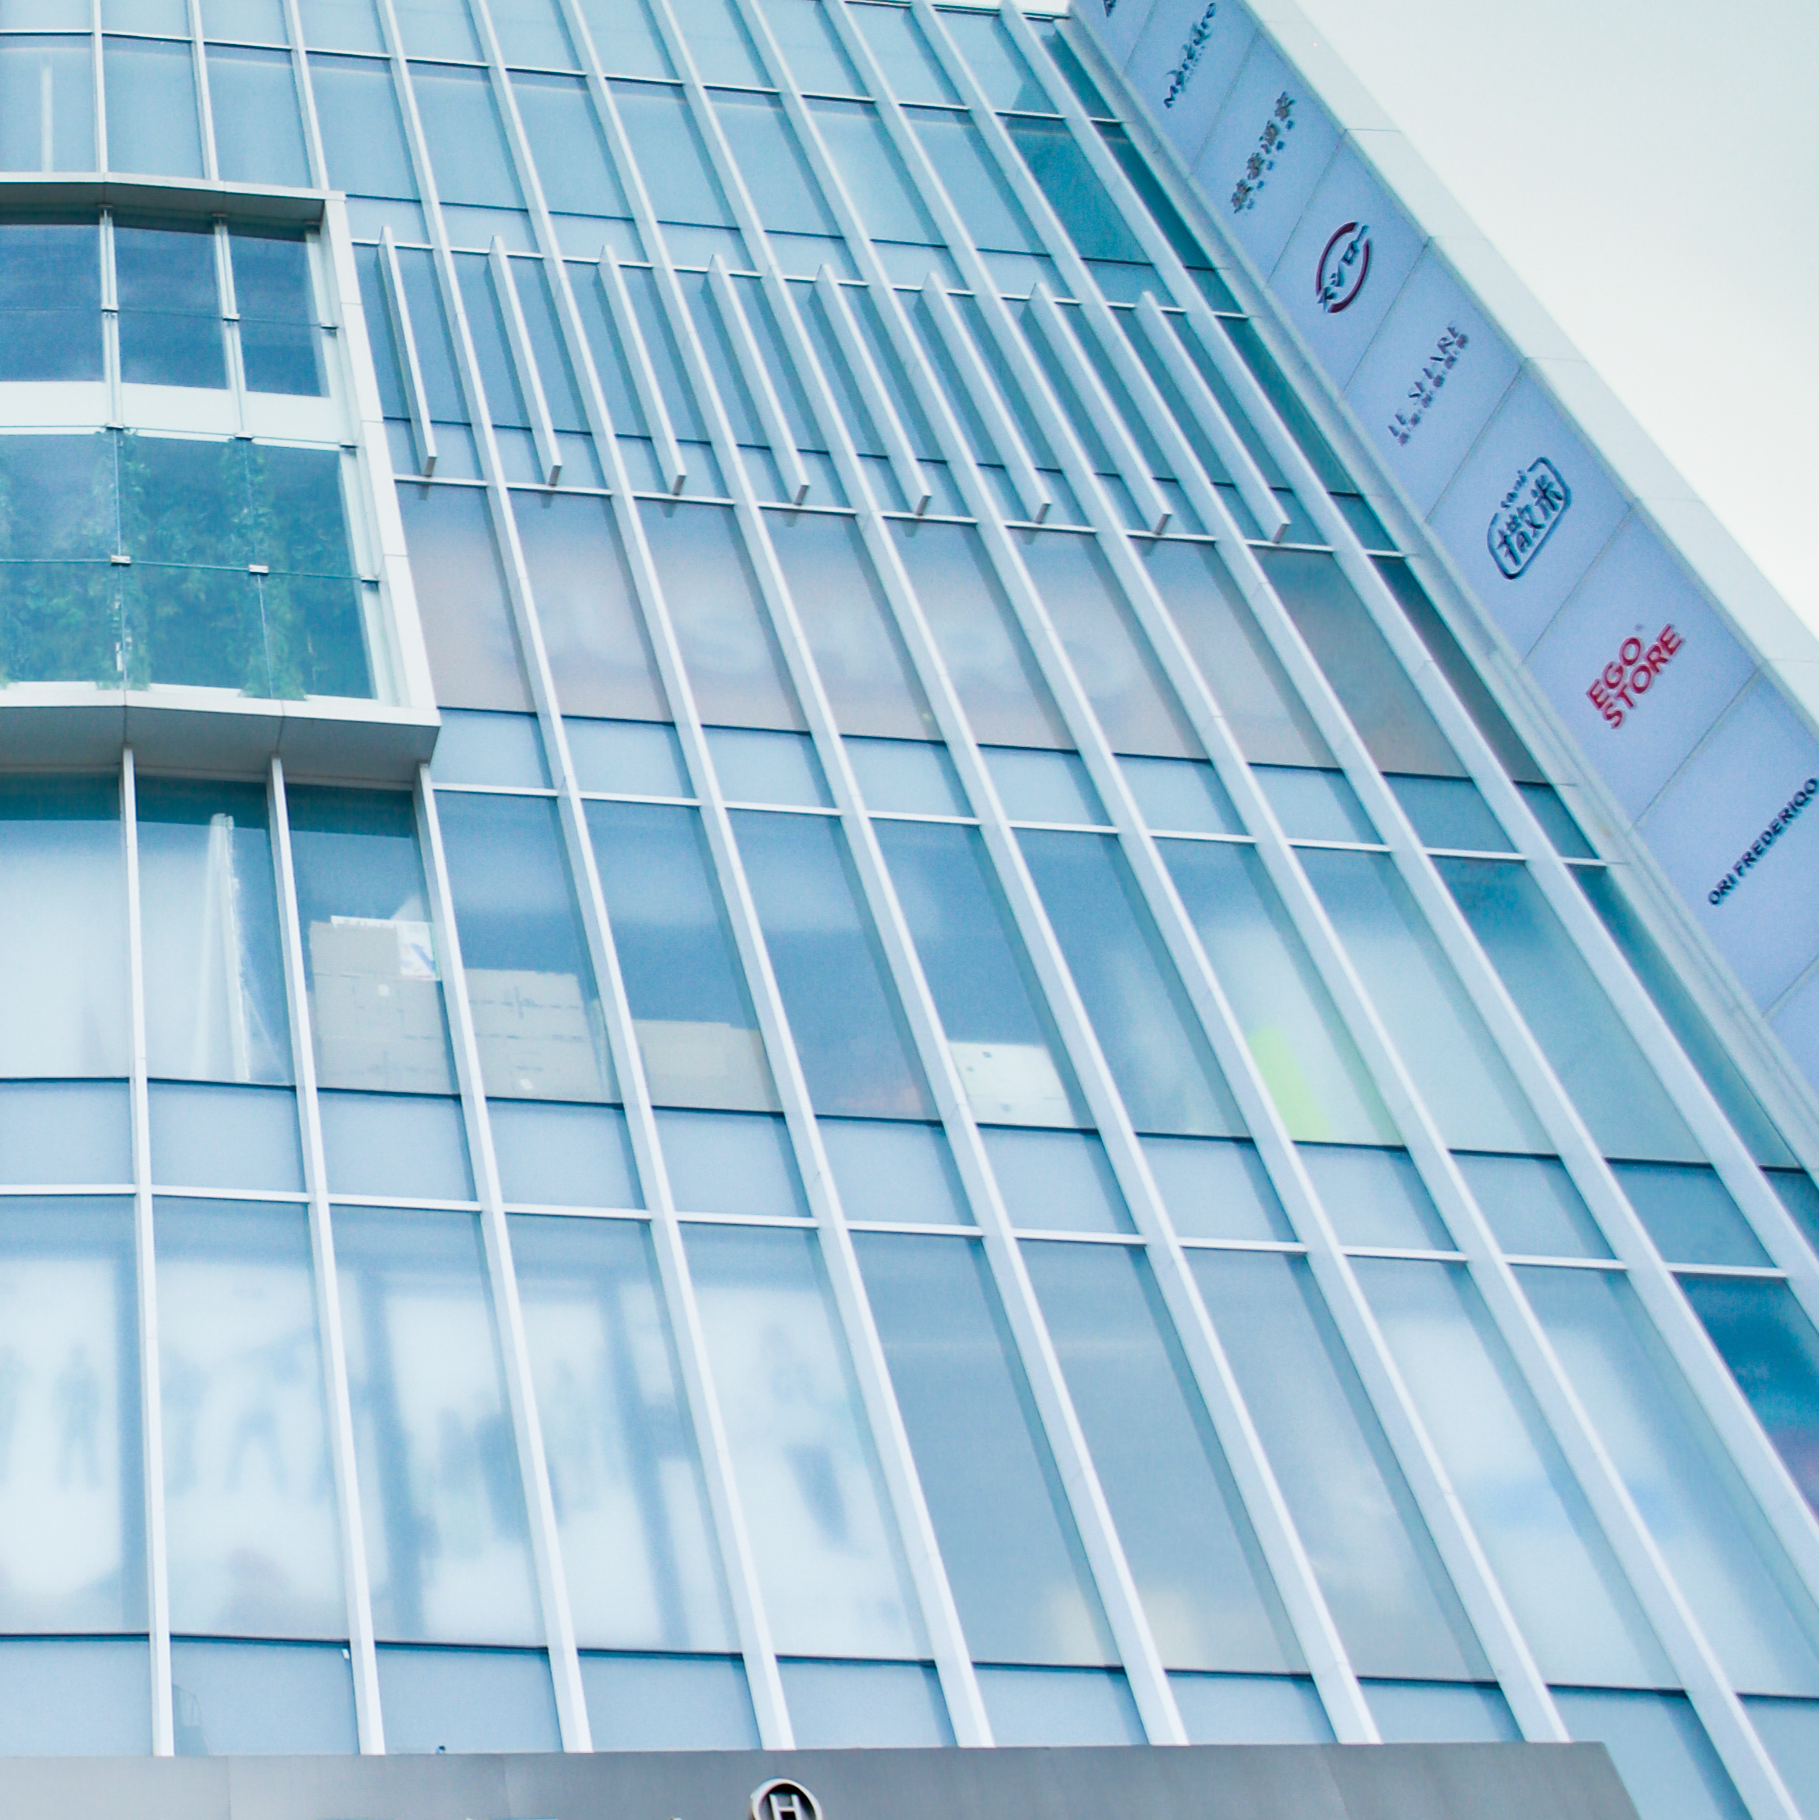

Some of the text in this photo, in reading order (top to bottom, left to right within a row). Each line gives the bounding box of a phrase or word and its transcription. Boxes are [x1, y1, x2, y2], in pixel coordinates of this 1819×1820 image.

[1497, 474, 1564, 567] 撒米
[1586, 636, 1642, 711] EGO
[1602, 624, 1686, 730] STORE
[1707, 778, 1819, 906] ORI FREDERIQO
